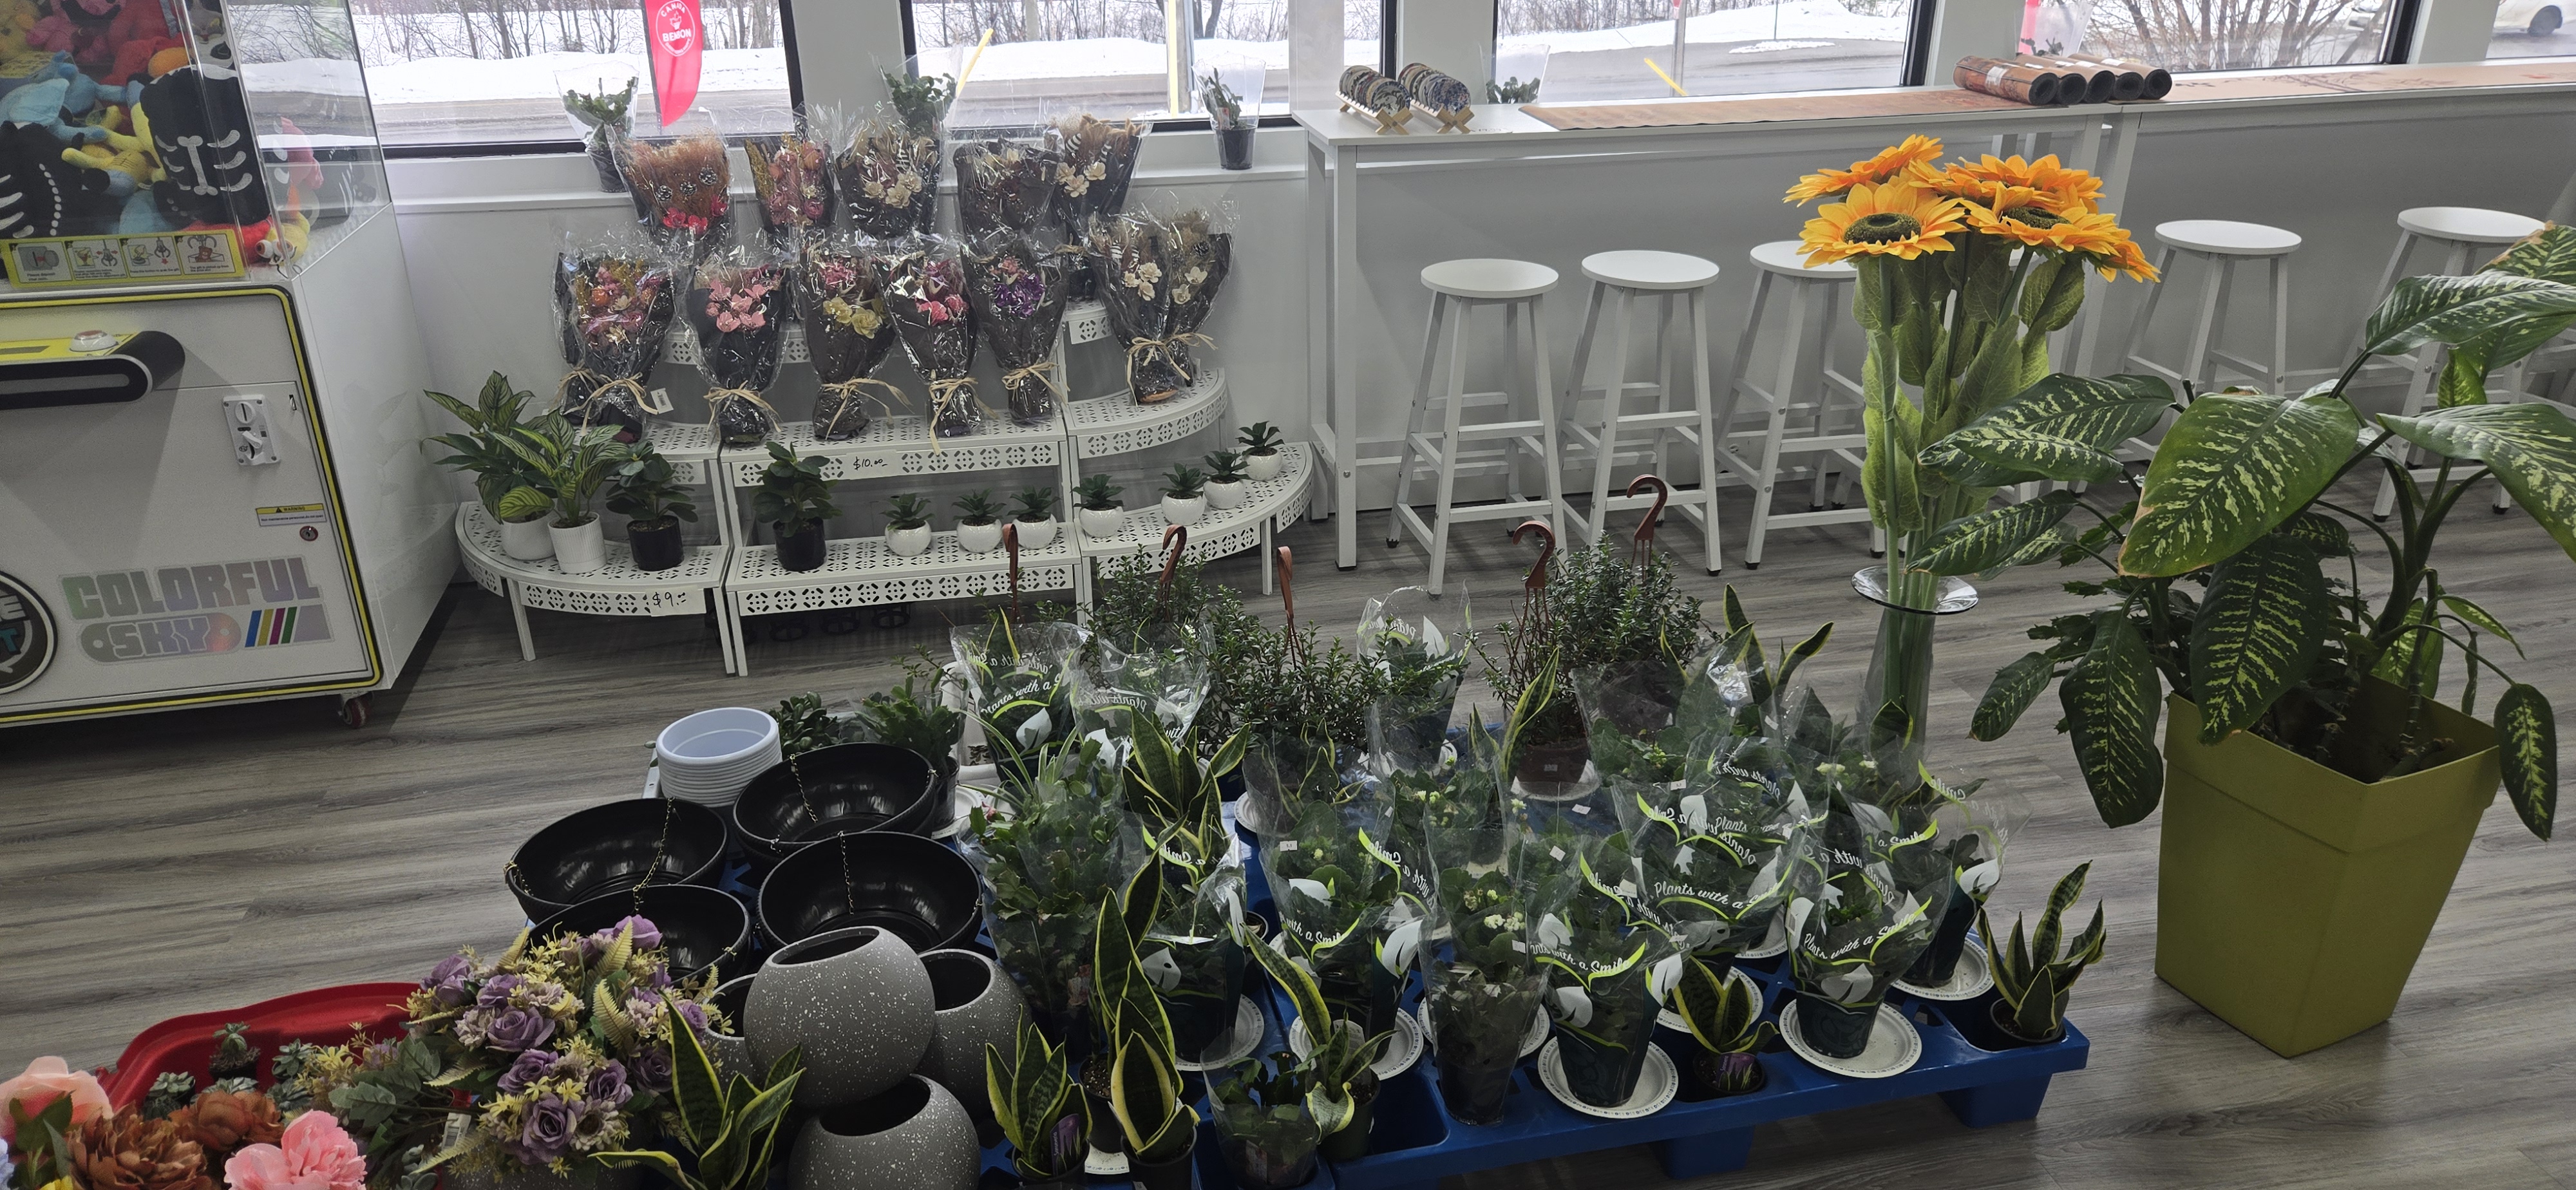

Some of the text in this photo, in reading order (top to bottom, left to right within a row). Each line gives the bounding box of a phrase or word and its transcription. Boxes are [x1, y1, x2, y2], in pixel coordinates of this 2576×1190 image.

[62, 558, 320, 619] COLORFUL
[106, 616, 211, 659] SKY
[1016, 679, 1039, 697] with
[1043, 681, 1052, 690] a
[1716, 816, 1748, 836] Plants
[1878, 839, 1888, 847] a
[1654, 881, 1695, 898] Plants
[1698, 889, 1729, 905] with
[1732, 900, 1743, 909] a
[1305, 932, 1314, 942] a
[1831, 938, 1861, 959] with
[1863, 935, 1874, 945] a
[1877, 914, 1916, 940] Smile
[1552, 948, 1576, 965] with
[1579, 961, 1589, 971] a
[1591, 957, 1631, 974] Smile
